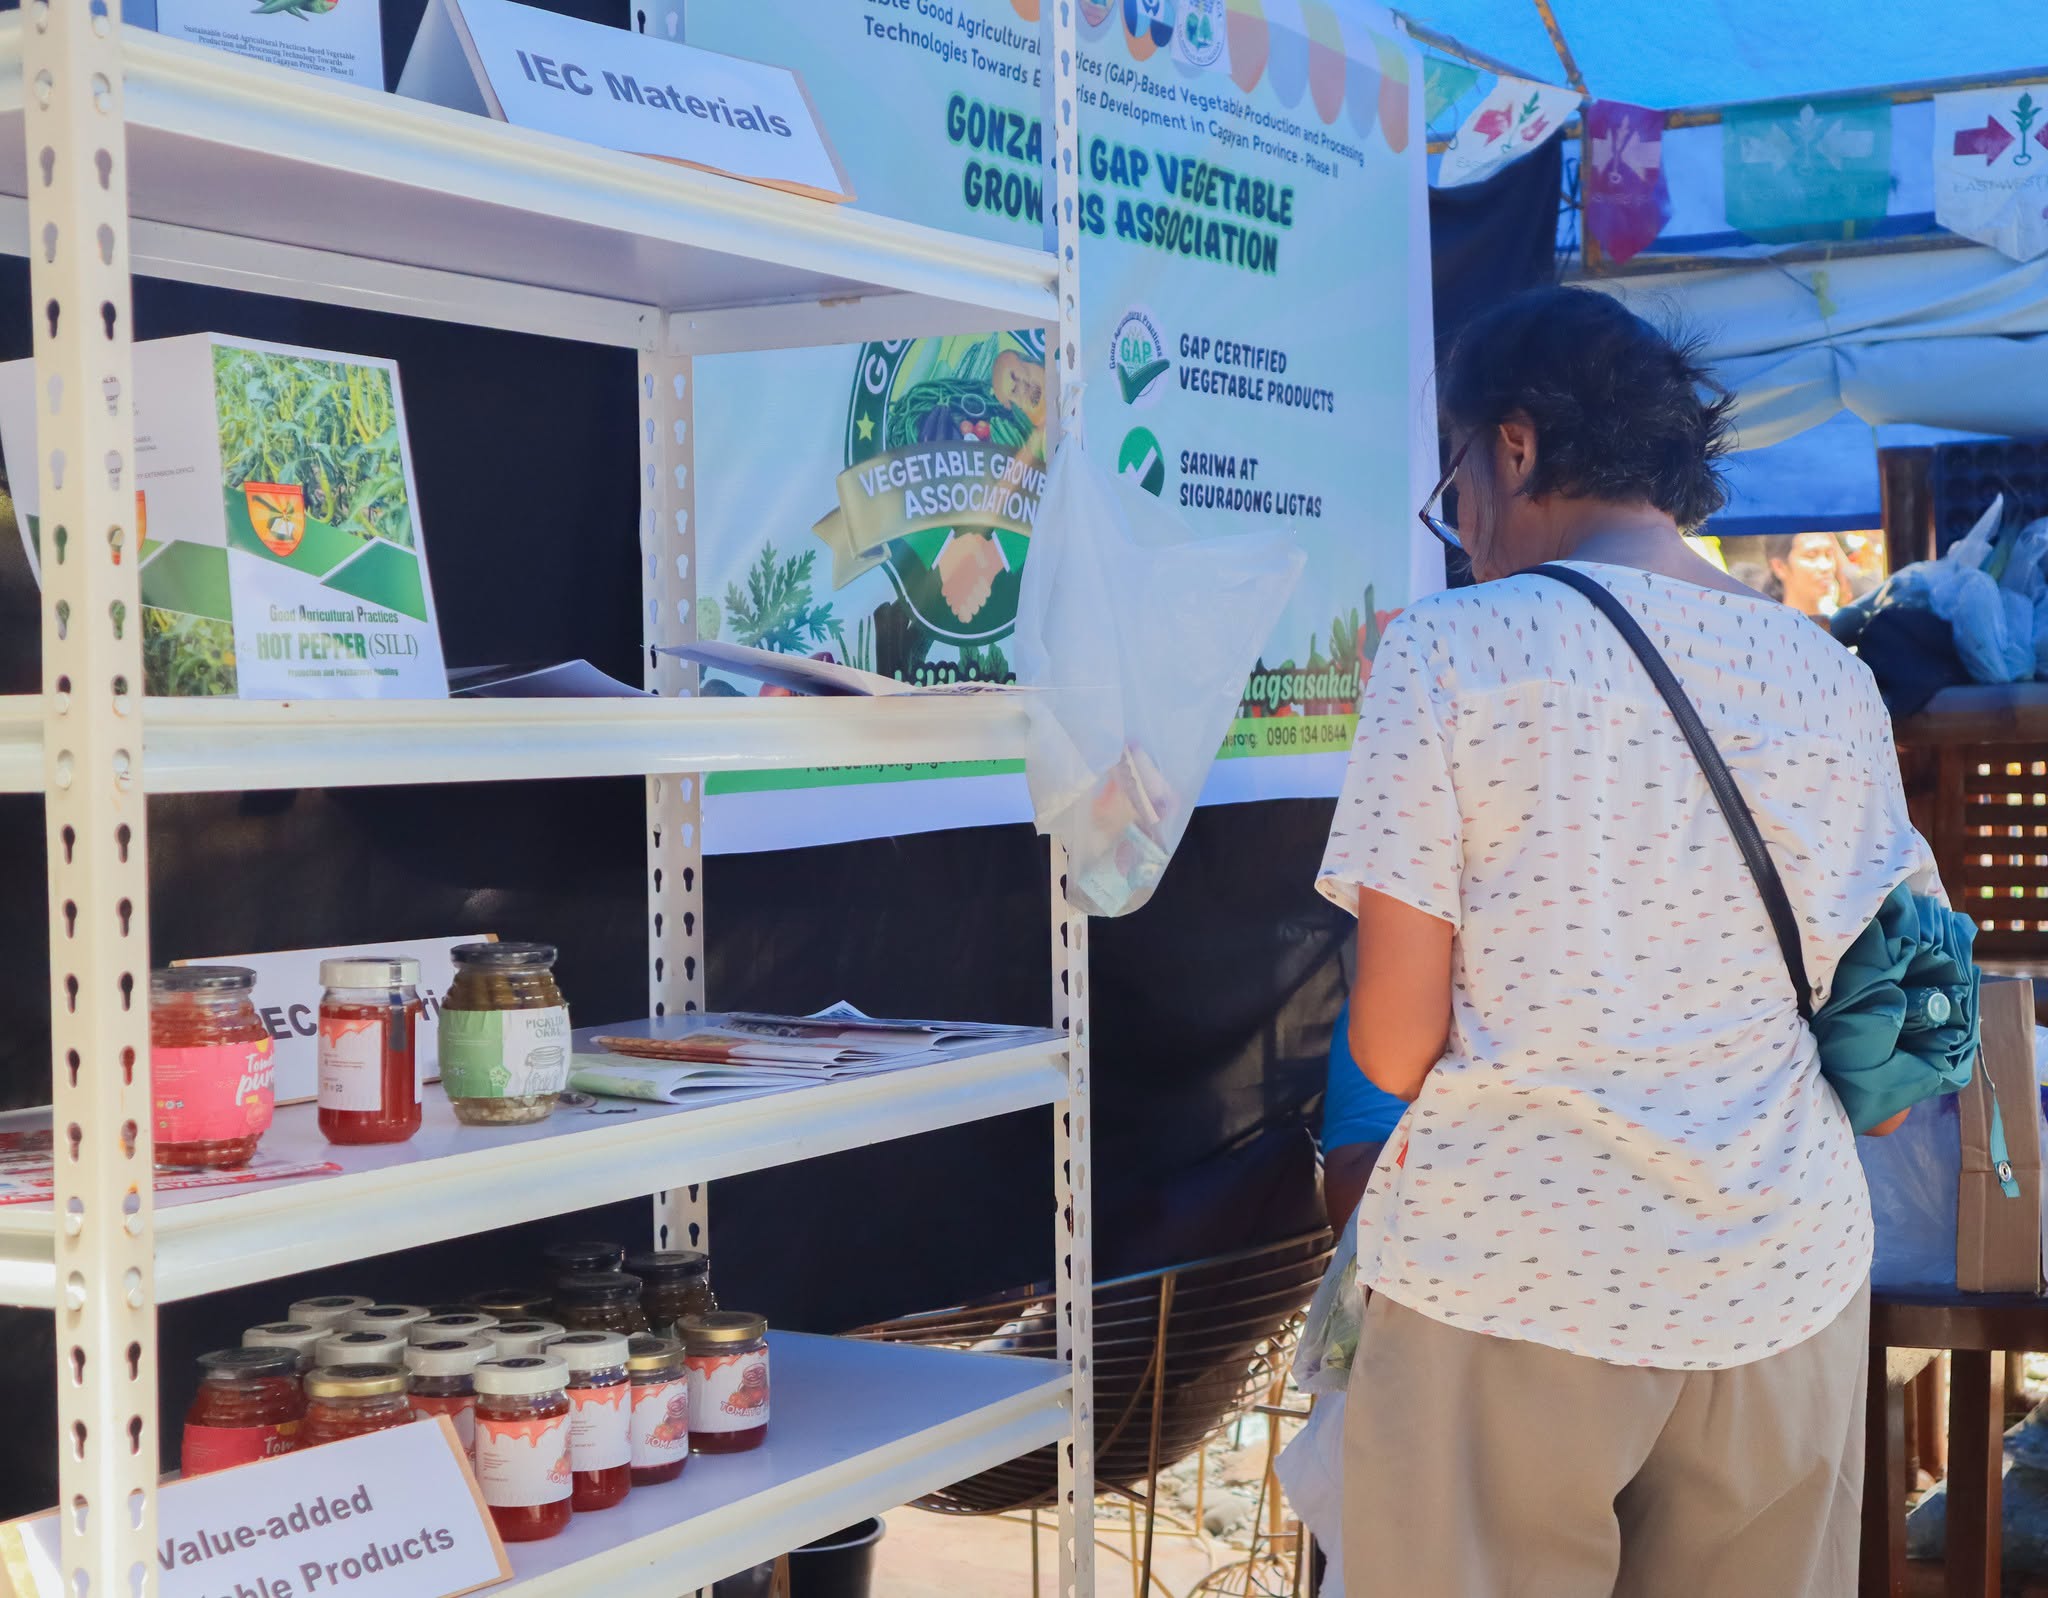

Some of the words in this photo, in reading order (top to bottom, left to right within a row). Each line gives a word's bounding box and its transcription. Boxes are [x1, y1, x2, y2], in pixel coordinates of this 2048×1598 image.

[222, 31, 239, 41] Good
[279, 40, 306, 52] Practices
[308, 46, 325, 56] Based
[326, 48, 355, 61] Vegetable
[236, 42, 247, 50] and
[282, 50, 316, 64] Technology
[318, 55, 342, 67] Towards
[515, 49, 593, 96] IEC
[602, 70, 792, 138] Materials
[864, 15, 968, 63] Technologies
[972, 49, 1028, 85] Towards
[1100, 90, 1187, 132] Development
[1191, 117, 1205, 134] in
[1209, 123, 1250, 150] Cagayan
[1253, 135, 1298, 164] Province
[1306, 156, 1331, 177] Phase
[957, 12, 1041, 56] Agricultural
[1105, 62, 1176, 101] (GAP)-Based
[1180, 86, 1244, 119] Vegetable
[1245, 106, 1302, 138] Production
[1303, 126, 1319, 144] and
[1321, 133, 1366, 167] Processing
[1090, 137, 1149, 188] GAP
[1156, 152, 1294, 226] VEGETABLE
[1115, 200, 1279, 273] ASSOCIATION
[1121, 337, 1152, 363] GAP
[1180, 333, 1210, 360] GAP
[1214, 339, 1287, 374] CERTIFIED
[1179, 365, 1264, 401] VEGETABLE
[1267, 380, 1334, 413] PRODUCTS
[858, 450, 985, 498] VEGETABLE
[1180, 450, 1236, 479] SARIWA
[1240, 457, 1259, 481] AT
[904, 483, 1038, 524] ASSOCIATION
[1180, 483, 1272, 514] SIGURADONG
[1275, 492, 1322, 518] LIGTAS
[270, 604, 296, 623] Good
[299, 604, 355, 624] Agricultural
[356, 605, 399, 624] Practices
[256, 632, 292, 660] HOT
[297, 632, 367, 660] PEPPER
[369, 633, 419, 661] (SILI)
[1267, 725, 1297, 747] 0906
[1300, 725, 1318, 745] 134
[259, 1003, 318, 1041] EC
[157, 1484, 374, 1572] Value-added
[299, 1524, 455, 1592] Products
